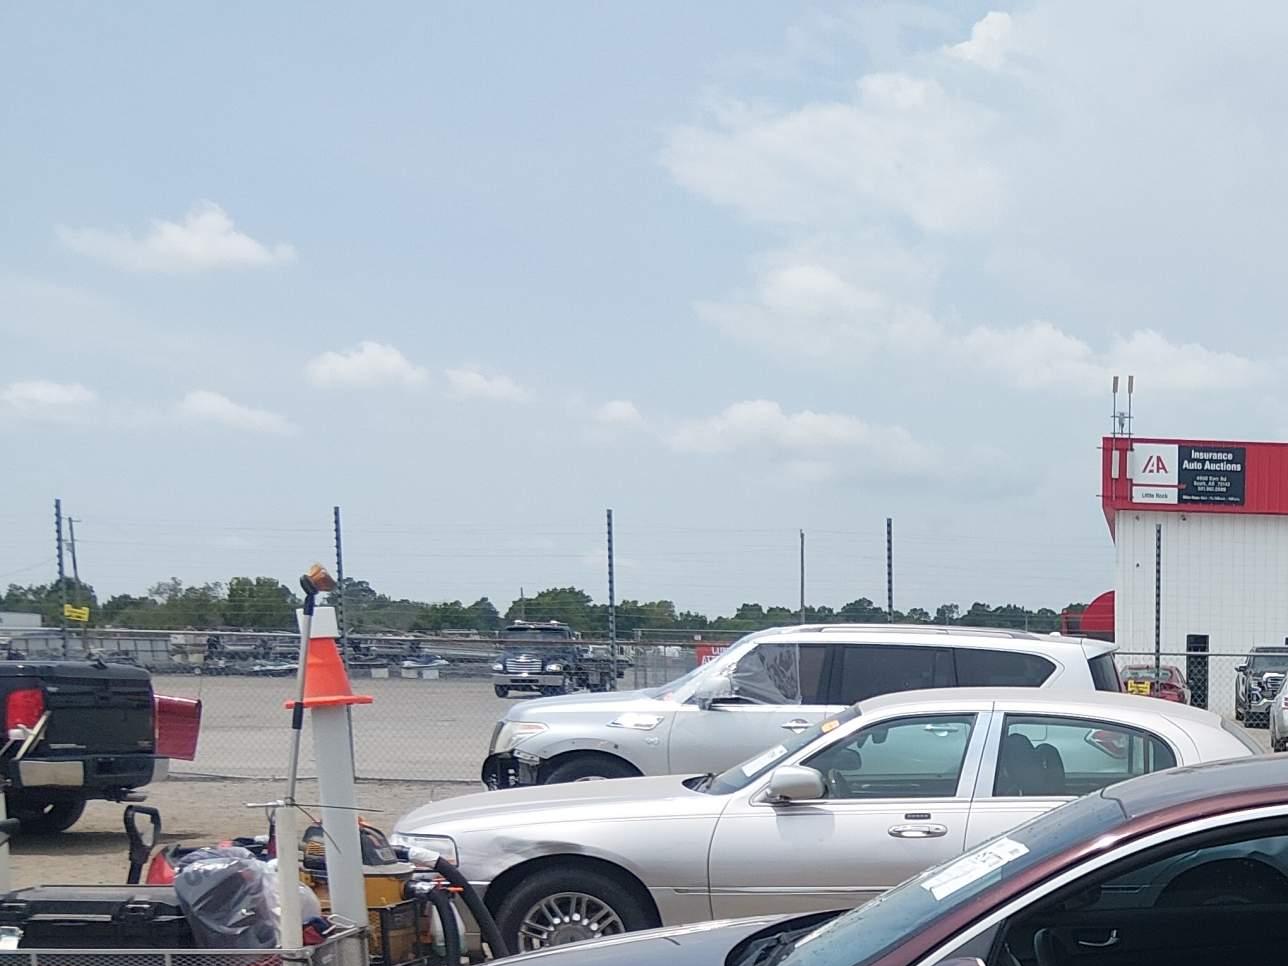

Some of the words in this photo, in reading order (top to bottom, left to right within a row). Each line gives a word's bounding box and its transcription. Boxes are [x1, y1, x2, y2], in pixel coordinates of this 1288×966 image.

[1191, 449, 1233, 460] Insurance
[1182, 460, 1203, 470] Auto
[1204, 461, 1242, 472] Auctions
